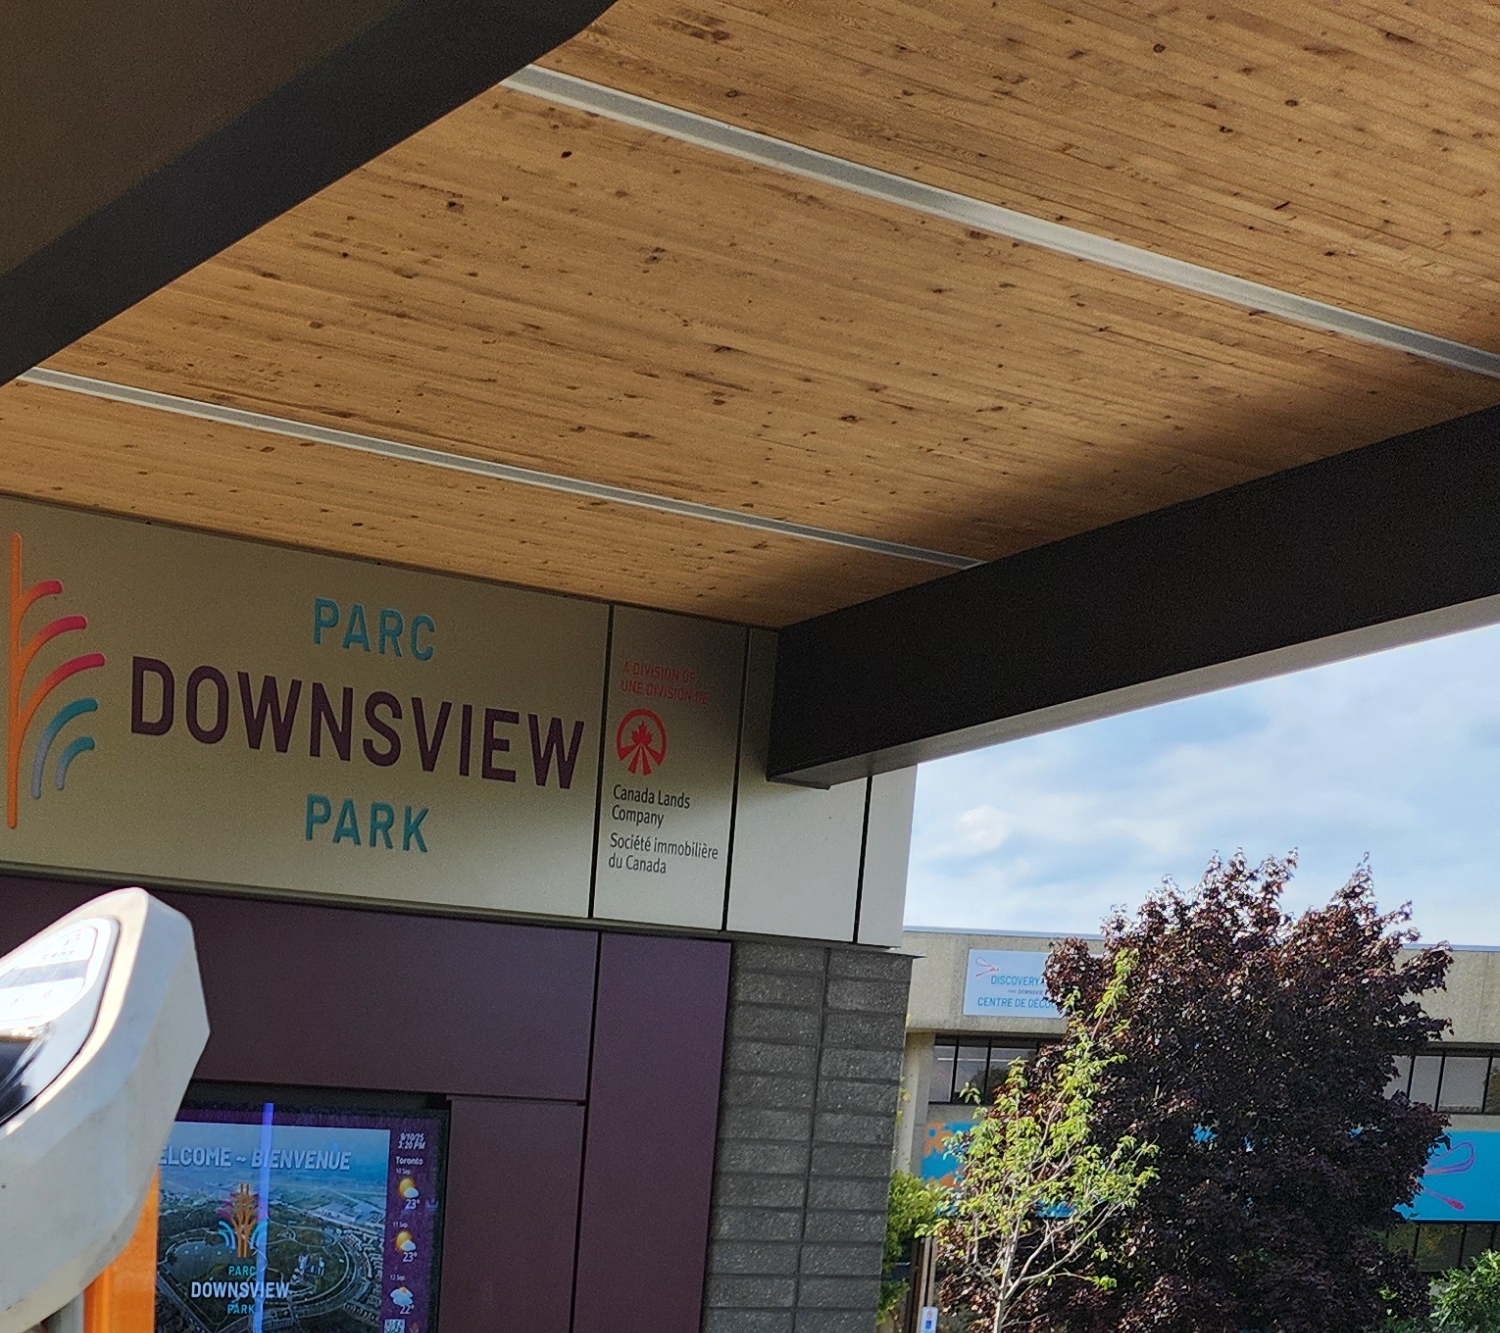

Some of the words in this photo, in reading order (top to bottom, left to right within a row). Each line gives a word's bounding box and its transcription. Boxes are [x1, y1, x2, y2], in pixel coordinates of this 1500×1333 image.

[313, 597, 436, 661] PARC
[622, 660, 630, 674] A
[633, 662, 680, 681] DIVISION
[621, 680, 643, 695] UNE
[645, 683, 692, 703] DIVISION
[131, 656, 585, 790] DOWNSVIEW
[613, 784, 655, 804] Canada
[658, 789, 691, 809] Lands
[306, 794, 430, 853] PARK
[611, 804, 665, 829] Company
[610, 832, 652, 852] Société
[654, 837, 719, 860] immobilière
[608, 852, 623, 869] du
[625, 855, 667, 874] Canada
[991, 975, 1040, 987] DISCOVERY
[977, 996, 1013, 1008] CENTRE
[1014, 998, 1027, 1008] DE
[1028, 997, 1056, 1010] DÉCOU
[158, 1145, 231, 1167] ELCOME
[251, 1148, 352, 1171] BIENVENUE
[396, 1156, 423, 1165] Toronto
[228, 1265, 257, 1276] PARC
[191, 1281, 290, 1299] DOWNSVIEW
[227, 1303, 256, 1315] PARK
